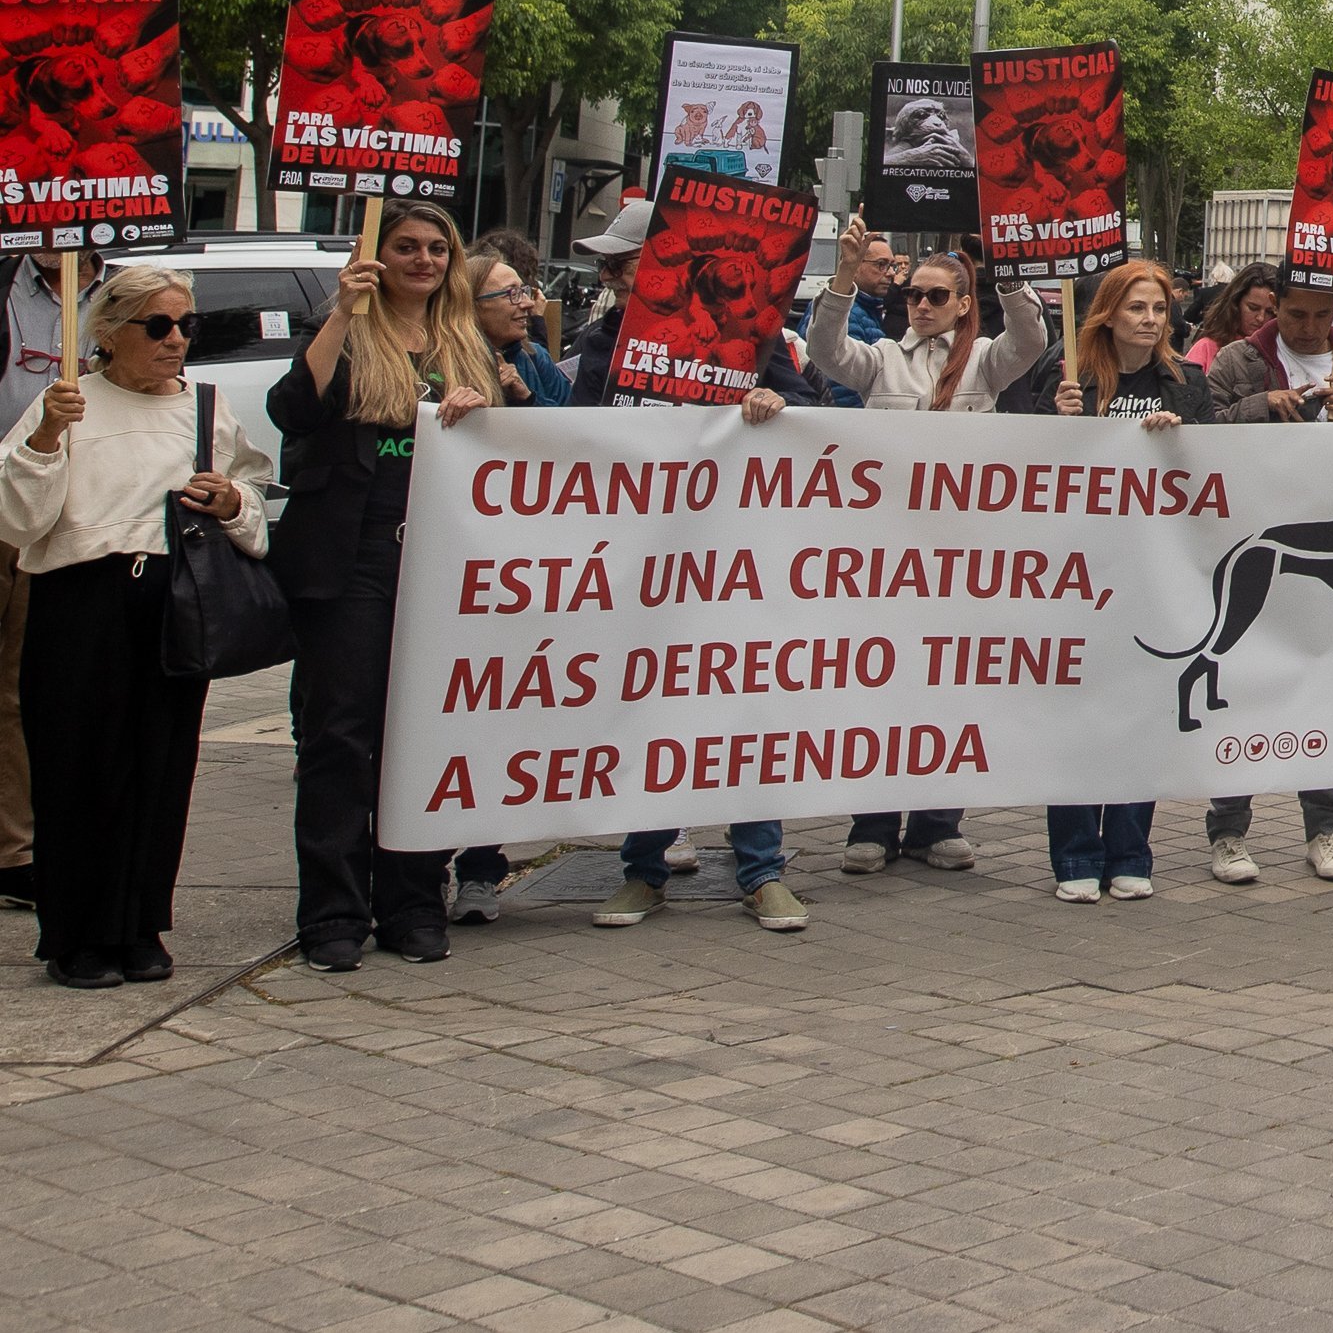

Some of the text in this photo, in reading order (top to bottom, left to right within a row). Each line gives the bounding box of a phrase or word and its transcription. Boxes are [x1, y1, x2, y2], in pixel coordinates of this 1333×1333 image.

[983, 50, 1115, 85] ¡JUSTICIA!
[888, 78, 972, 97] NO NOS OLVIDÉ
[288, 111, 333, 126] PARA
[285, 125, 462, 158] LAS VÍCTIMAS
[282, 146, 458, 176] DE VIVOTECNIA
[883, 168, 975, 179] #RESCATEVIVOTECNIA
[29, 175, 169, 203] VÍCTIMAS
[670, 177, 814, 229] ¡JUSTICIA!
[6, 196, 172, 224] VIVOTECNIA
[991, 213, 1028, 226] PARA
[991, 210, 1121, 243] LAS VÍCTIMAS
[1295, 222, 1325, 235] PARA
[993, 242, 1019, 259] DE
[1023, 228, 1122, 257] VIVOTECNIA
[1294, 234, 1328, 253] LAS
[1292, 251, 1313, 265] DE
[627, 338, 668, 356] PARA
[618, 370, 648, 390] DE
[622, 351, 759, 390] LAS VÍCTIMAS
[377, 438, 415, 456] AC
[471, 444, 1231, 520] CUANTO MÁS INDEFENSA
[458, 540, 1116, 616] ESTÁ UNA CRIATURA,
[442, 636, 1087, 715] MÁS DERECHO TIENE
[425, 722, 990, 814] A SER DEFENDIDA
